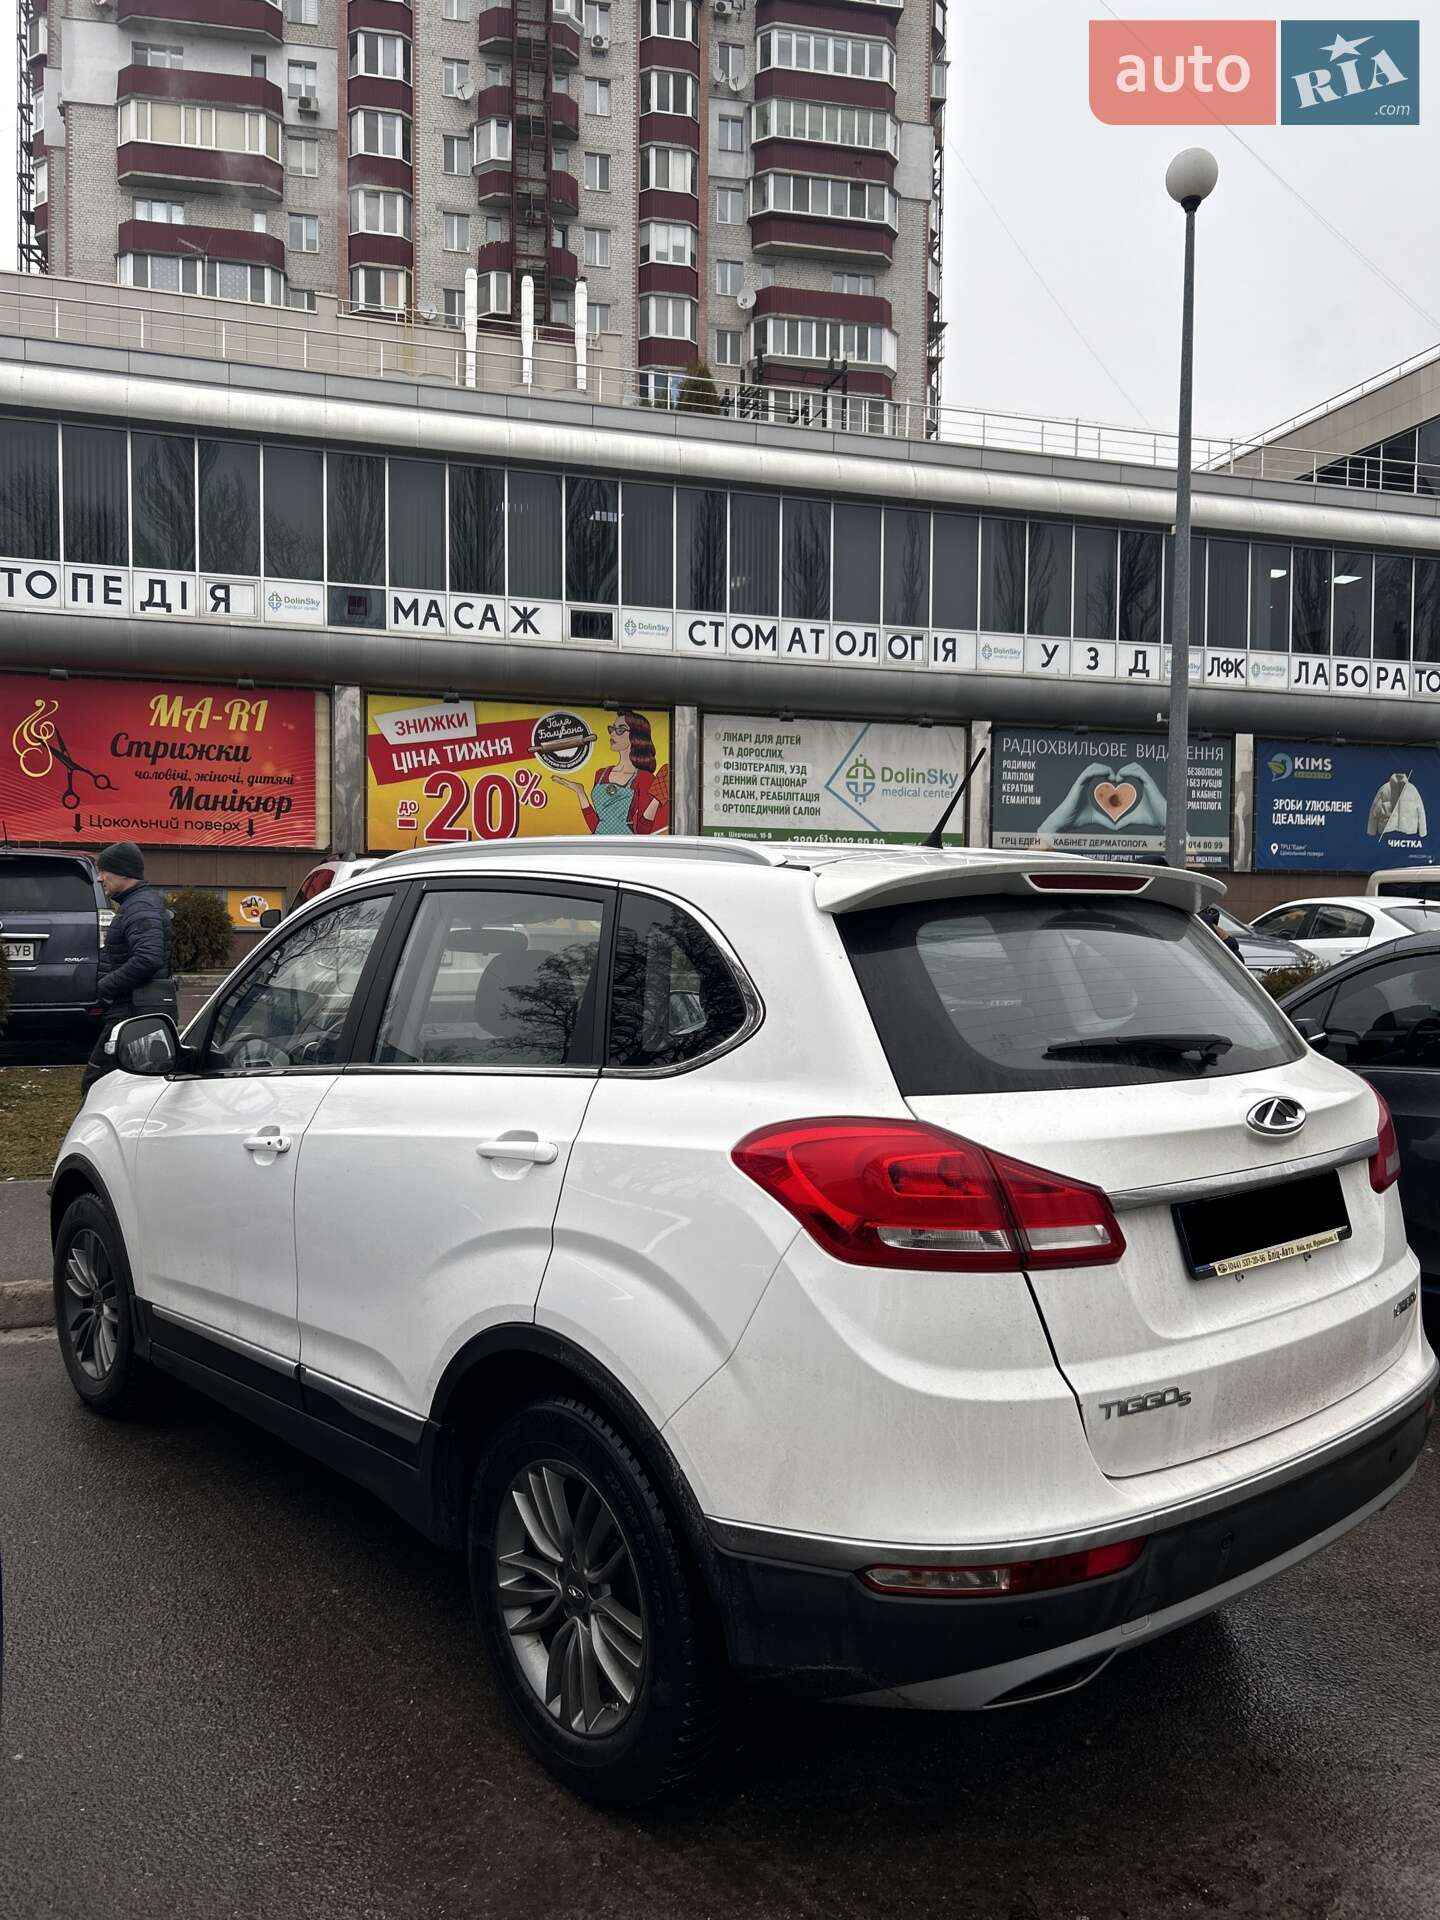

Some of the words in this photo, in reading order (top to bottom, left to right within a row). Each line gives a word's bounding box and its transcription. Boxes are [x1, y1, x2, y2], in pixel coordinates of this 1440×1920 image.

[393, 597, 541, 635] МАСАЖ
[688, 620, 957, 662] СТОМАТОЛОГІЯ
[1207, 656, 1246, 679] ЛФК
[394, 712, 469, 736] ЗНИЖКИ
[722, 732, 752, 744] ЛІКАРІ
[754, 733, 773, 745] ДЛЯ
[775, 733, 801, 746] ДІТЕЙ
[110, 732, 252, 765] Стрижки
[392, 748, 441, 774] ЦІНА
[443, 737, 513, 763] ТИЖНЯ
[722, 746, 735, 757] ТА
[736, 747, 784, 759] ДОРОСЛИХ
[1002, 738, 1127, 758] РАДІОХВИЛЬОВЕ
[1136, 743, 1224, 762] ВИДЕННЯ
[723, 761, 788, 774] ФІЗІОТЕРАПІЯ,
[789, 765, 807, 776] УЗД
[1002, 760, 1036, 770] РОДИМОК
[1294, 756, 1332, 771] KIMS
[722, 774, 757, 786] ДЕННИЙ
[760, 776, 807, 788] СТАЦІОНАР
[881, 766, 959, 789] DolinSky
[1002, 771, 1034, 782] ПАПІЛОМ
[1189, 778, 1201, 788] БЕЗ
[881, 787, 921, 798] medical
[923, 789, 955, 799] center
[1002, 783, 1034, 793] КЕРАТОМ
[169, 785, 292, 819] Манікюр
[722, 789, 758, 801] МАСАЖ,
[760, 791, 820, 803] РЕАБІЛІТАЦІЯ
[722, 803, 790, 815] ОРТОПЕДИЧНИЙ
[793, 806, 821, 816] САЛОН
[1273, 799, 1303, 811] ЗРОБИ
[1305, 800, 1353, 813] УЛЮБЛЕНЕ
[89, 815, 179, 830] Цокольний
[184, 819, 241, 833] поверх
[1272, 813, 1326, 826] ІДЕАЛЬНИМ
[1019, 837, 1041, 846] ЕДЕН
[1053, 837, 1086, 847] КАБІНЕТ
[1089, 838, 1148, 848] ДЕРМАТОЛОГА
[1388, 839, 1423, 849] ЧИСТКА
